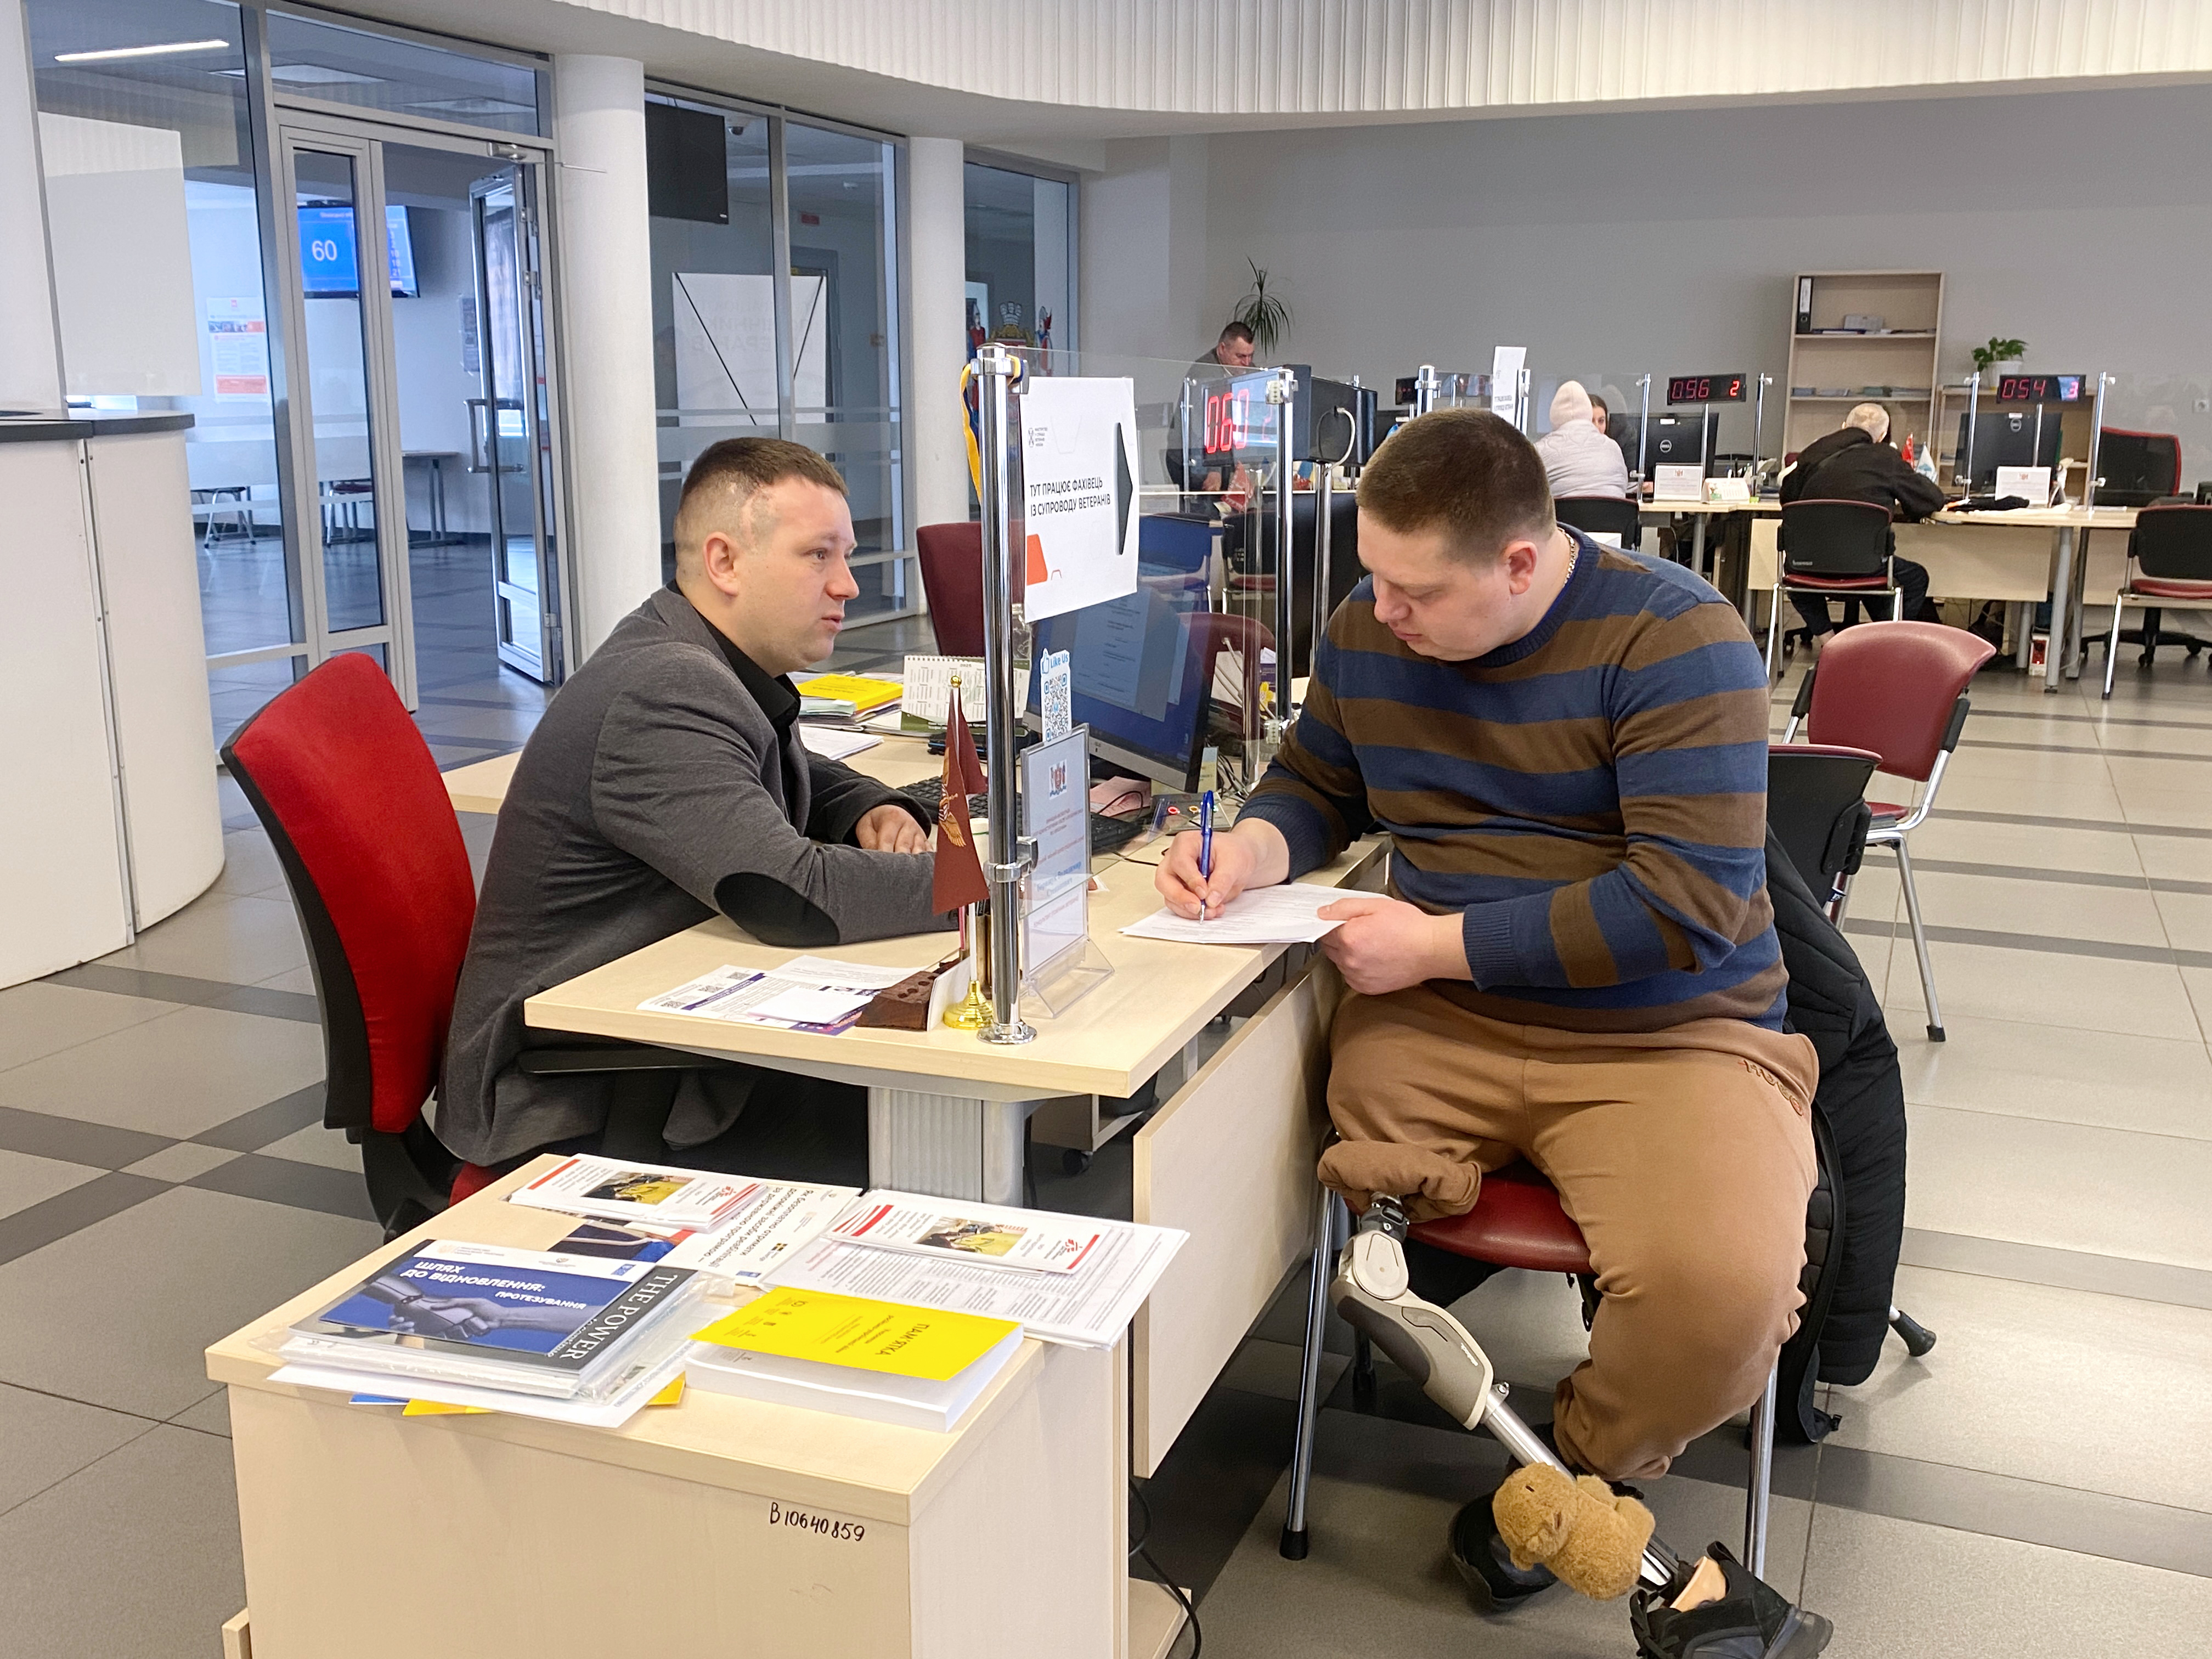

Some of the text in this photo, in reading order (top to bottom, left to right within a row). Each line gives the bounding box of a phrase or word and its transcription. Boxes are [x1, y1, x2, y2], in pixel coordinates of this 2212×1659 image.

[312, 240, 337, 261] 60
[1672, 380, 1740, 399] 056 2
[2001, 379, 2079, 399] 054 3
[1030, 477, 1103, 497] ТУТ ПРАЦЮЄ ФАХІВЕЦЬ
[1031, 493, 1111, 517] ІЗ СУПРОВОДУ ВЕТЕРАНІВ
[1050, 653, 1069, 669] Like Us
[769, 1197, 806, 1229] безоплатно
[746, 1216, 769, 1237] засоби
[704, 1225, 741, 1257] програмою
[740, 1229, 771, 1256] отримати
[414, 1261, 466, 1274] ШЛЯХ
[400, 1269, 545, 1293] ДО ВІДНОВЛЕННЯ:
[628, 1275, 678, 1304] THE
[495, 1291, 586, 1310] ПРОТЕЗУВАННЯ
[560, 1305, 640, 1359] POWER
[874, 1323, 930, 1355] ПАМ'ЯТКА
